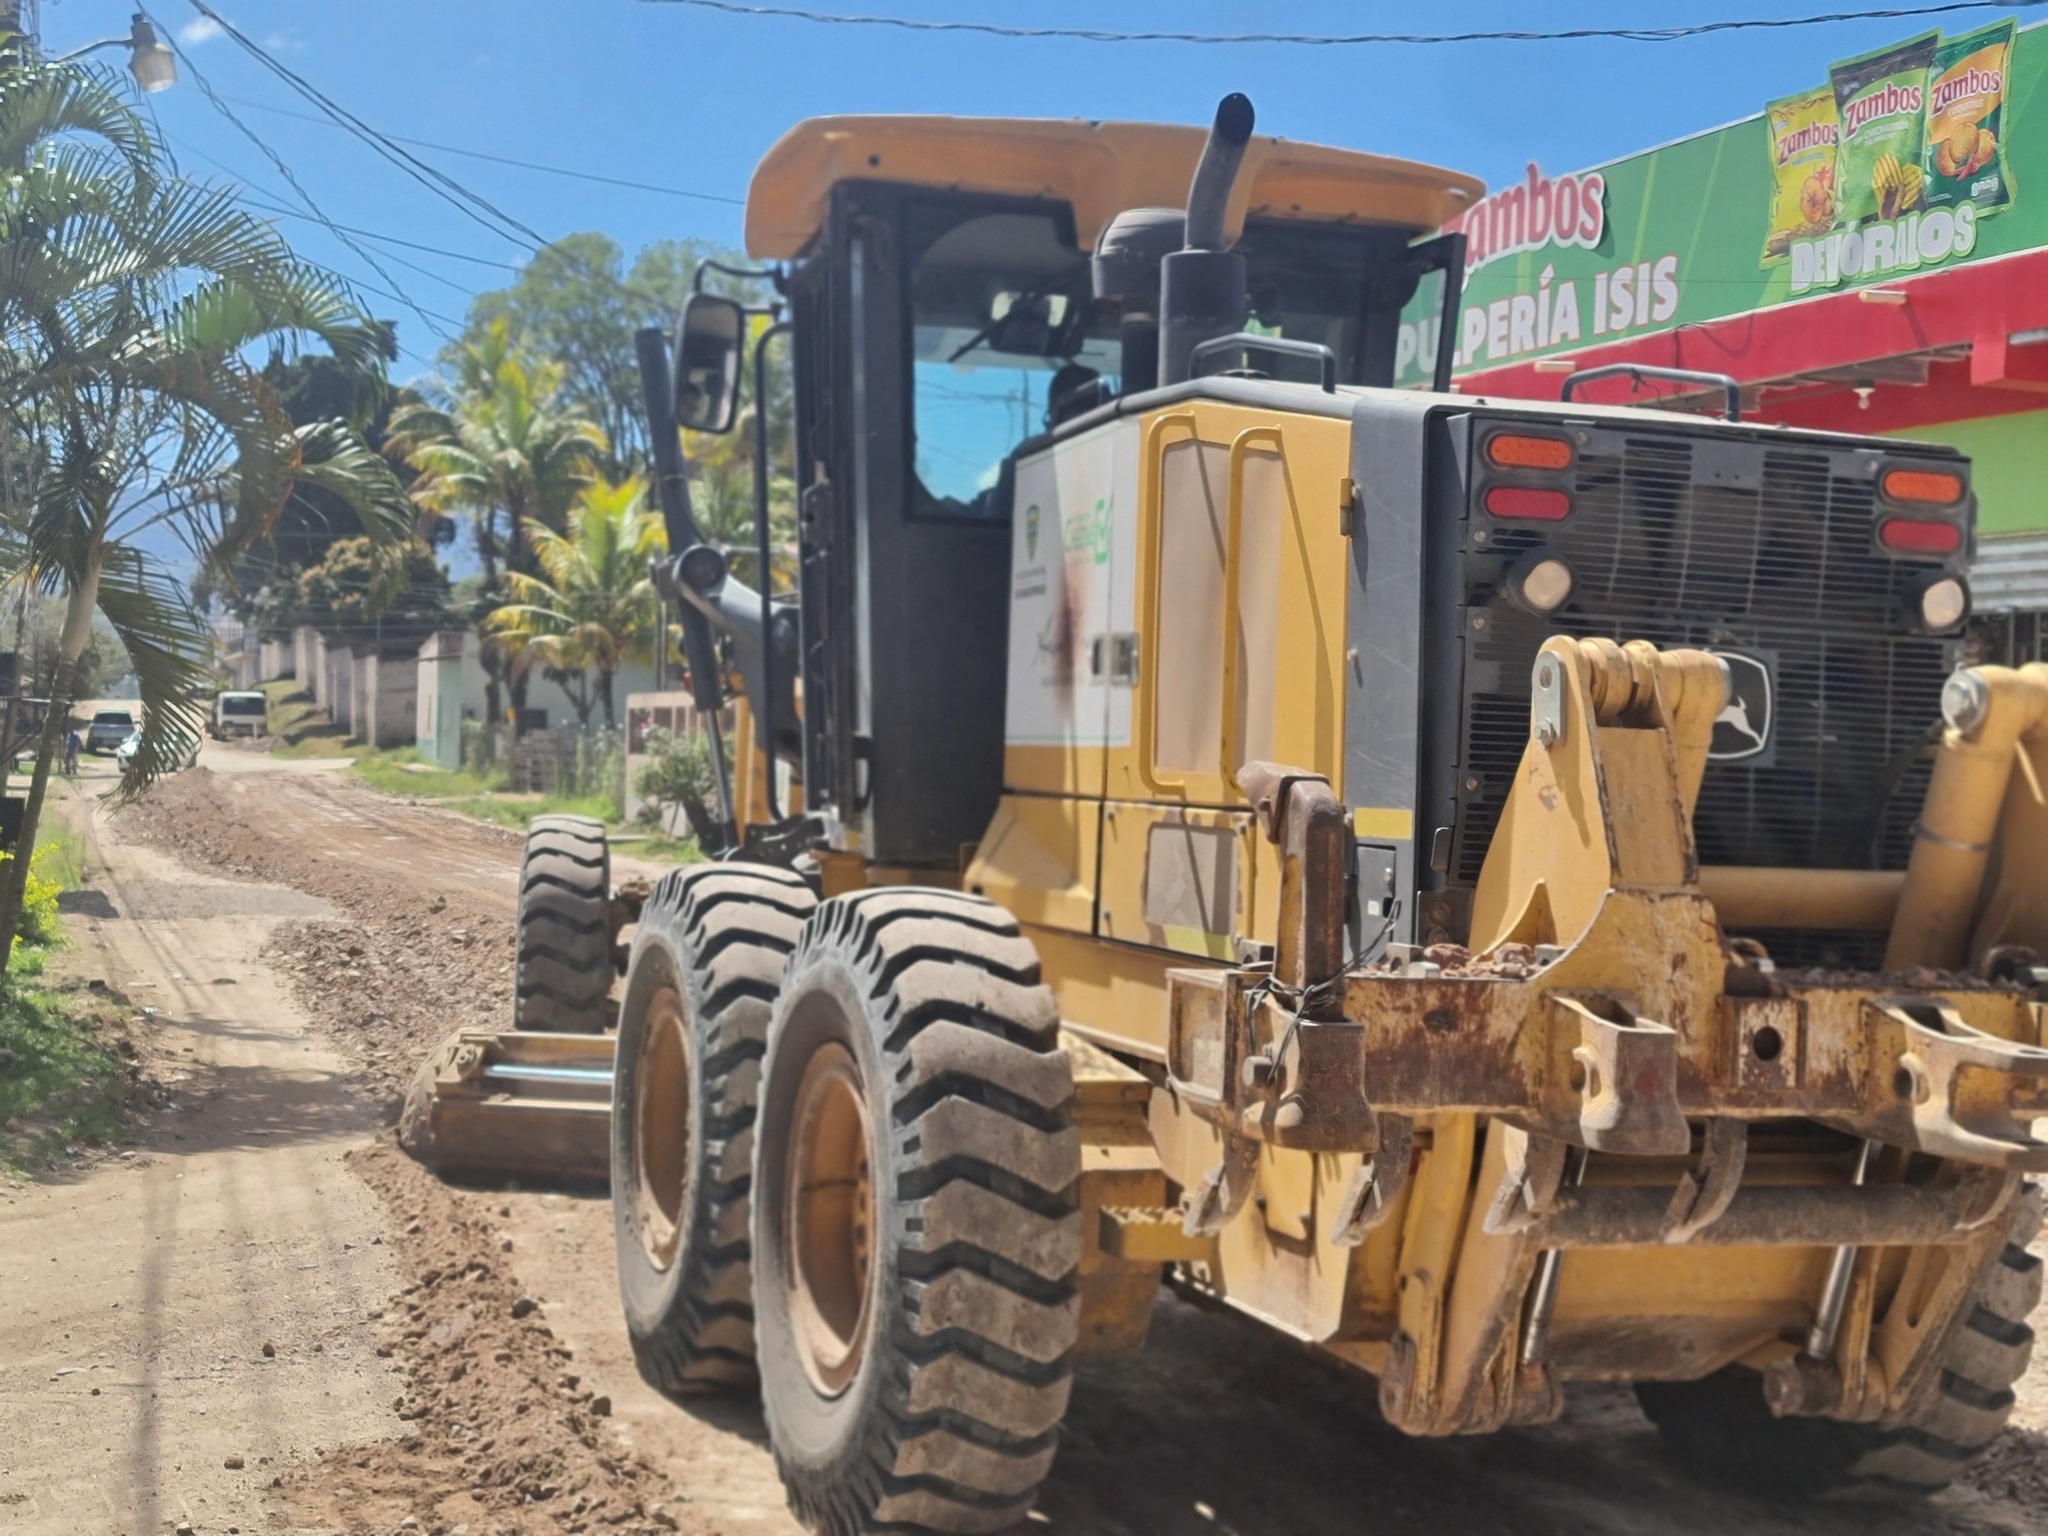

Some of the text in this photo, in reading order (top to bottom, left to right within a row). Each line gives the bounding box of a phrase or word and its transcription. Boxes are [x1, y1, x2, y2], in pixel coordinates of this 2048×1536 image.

[1844, 82, 1922, 139] Zambos
[1932, 68, 2000, 116] Zambos
[1776, 119, 1838, 168] Zambos
[1790, 204, 1975, 292] DEVÓRALOS
[1393, 254, 1679, 380] PUPERÍA ISIS
